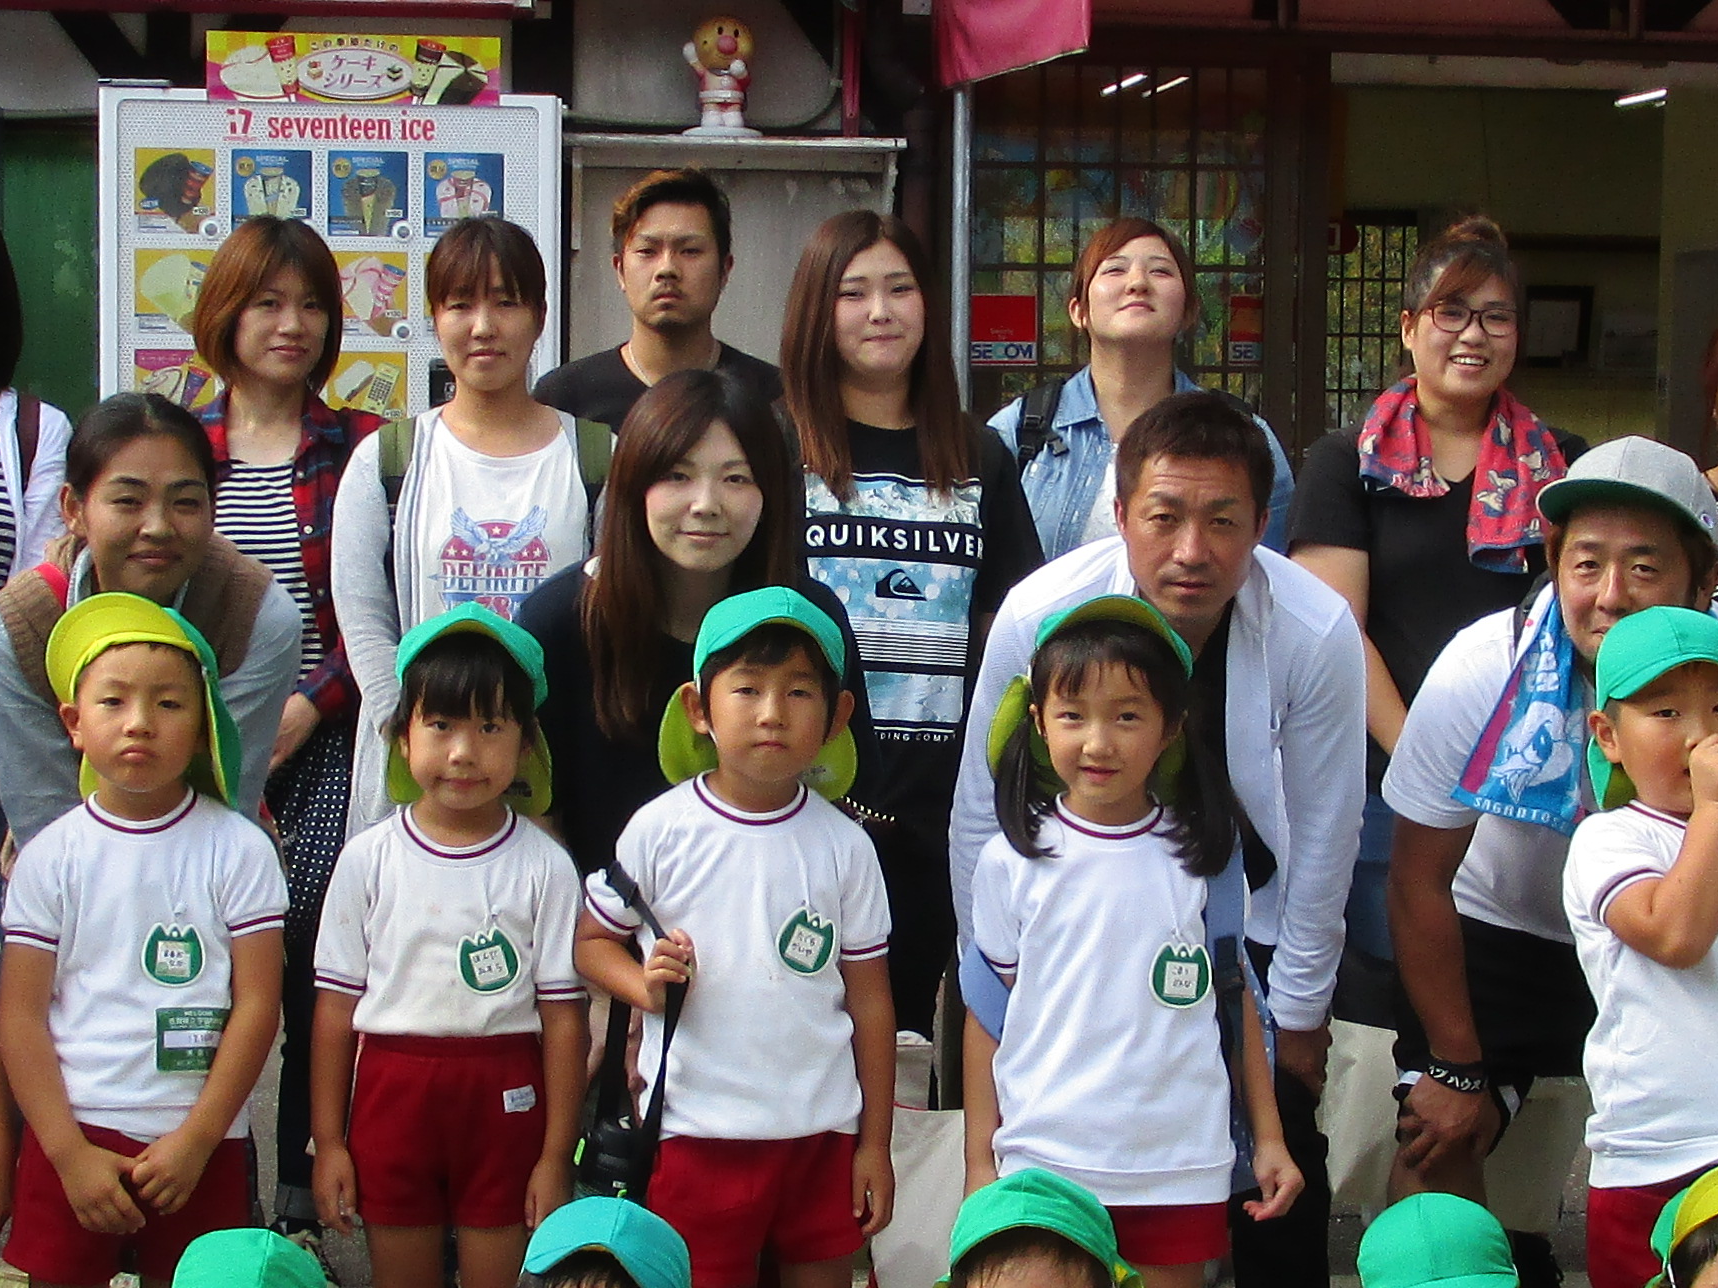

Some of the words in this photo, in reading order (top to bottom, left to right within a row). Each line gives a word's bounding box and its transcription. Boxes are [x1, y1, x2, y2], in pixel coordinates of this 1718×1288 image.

[332, 53, 376, 73] ケーキ
[323, 71, 385, 89] シリーズ
[267, 114, 392, 141] seventeen
[401, 111, 436, 141] ice
[970, 343, 1034, 360] SECOM
